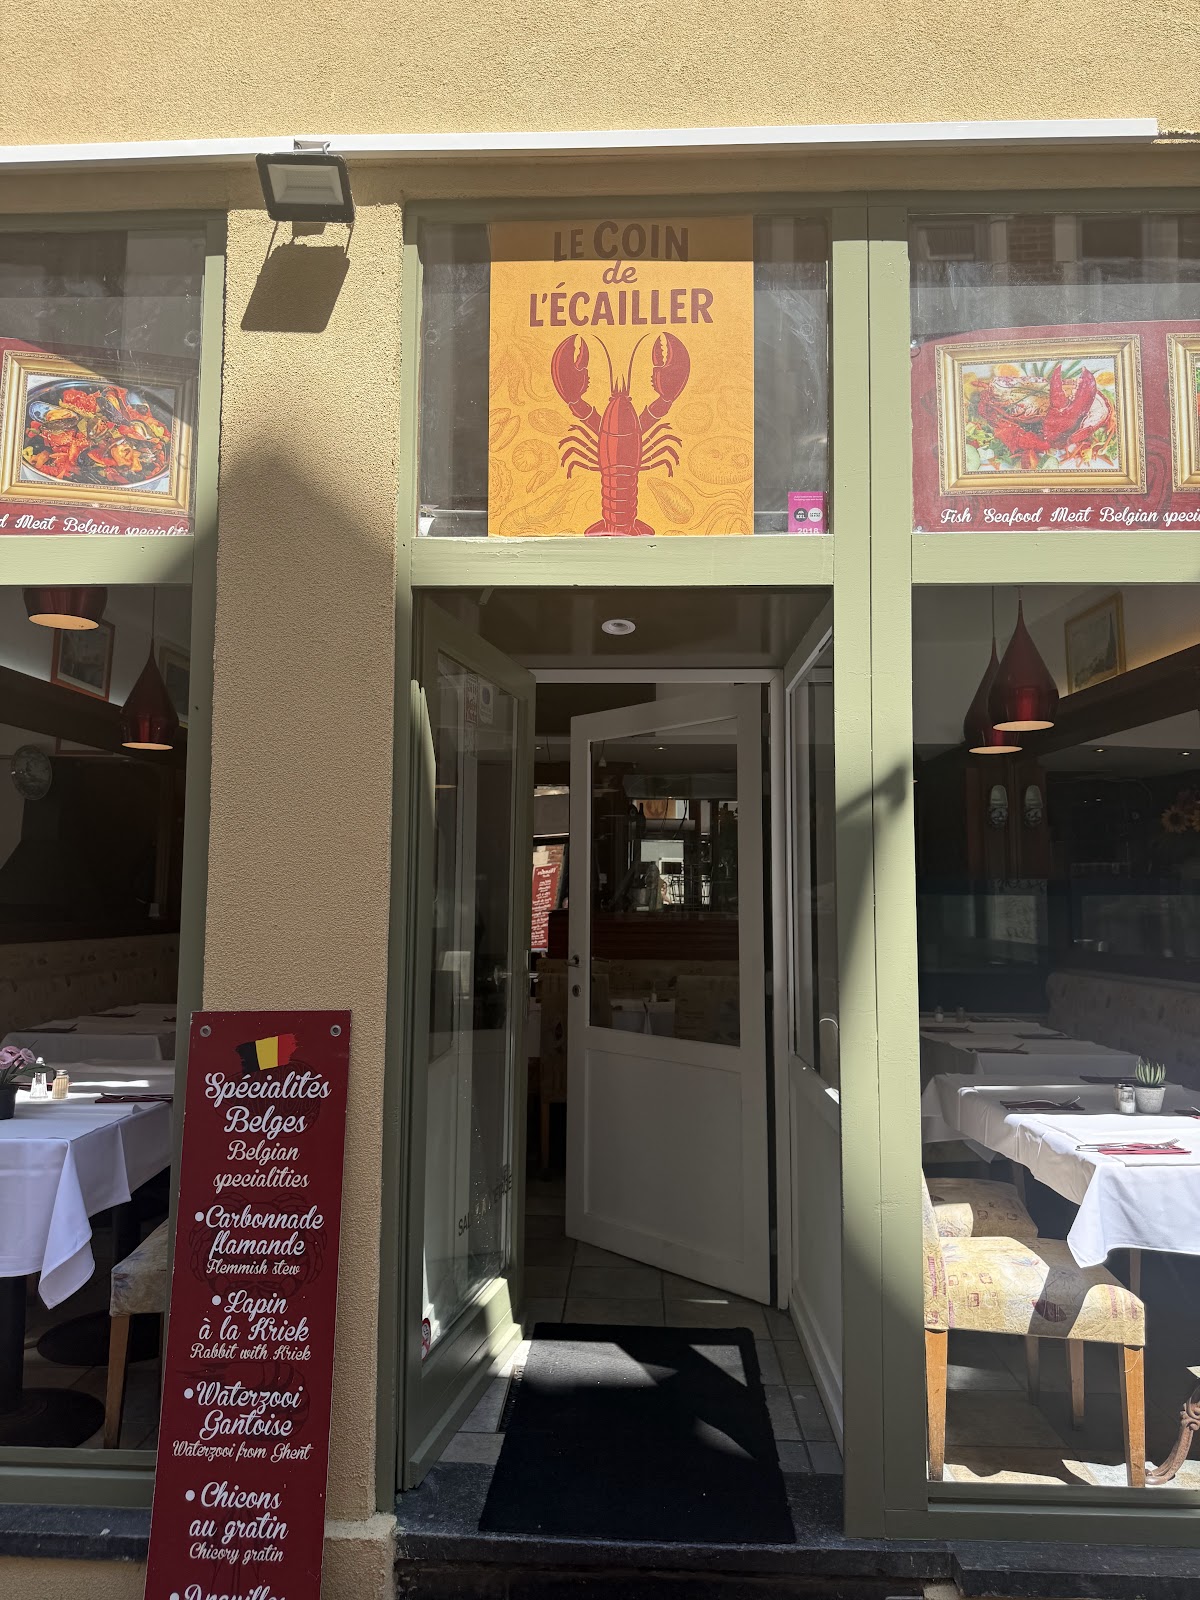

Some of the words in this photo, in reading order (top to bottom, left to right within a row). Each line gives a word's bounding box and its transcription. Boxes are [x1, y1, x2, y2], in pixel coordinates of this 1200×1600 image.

[553, 229, 585, 262] LE
[593, 220, 689, 262] COIN
[602, 261, 639, 285] de
[529, 282, 714, 327] L'ÉCAILLER
[15, 514, 58, 530] Meat
[63, 517, 120, 535] Belgian
[940, 507, 972, 523] Fish
[984, 507, 1043, 526] Seafood
[1050, 507, 1094, 522] Meat
[1099, 506, 1159, 526] Belgian
[1163, 508, 1200, 527] speci
[205, 1071, 332, 1108] Spécialités
[224, 1105, 308, 1140] Belges
[227, 1140, 301, 1166] Belgian
[213, 1166, 310, 1194] specialities
[206, 1204, 325, 1230] Carbonnade
[208, 1230, 306, 1260] flamande
[206, 1258, 269, 1275] Flemmish
[271, 1260, 301, 1276] stew
[224, 1289, 289, 1322] Lapin
[198, 1317, 214, 1340] à
[219, 1315, 242, 1341] la
[248, 1315, 310, 1342] Kriek
[189, 1343, 239, 1360] Rabbit
[240, 1344, 268, 1360] with
[272, 1345, 312, 1361] Kriek
[196, 1380, 304, 1415] Waterzooi
[199, 1409, 294, 1441] Gantoise
[172, 1440, 236, 1462] Waterzooi
[236, 1441, 267, 1462] from
[270, 1443, 314, 1463] Ghent
[200, 1480, 283, 1510] Chicons
[188, 1519, 218, 1538] au
[220, 1512, 289, 1545] gratin
[189, 1541, 240, 1565] Chicory
[242, 1544, 284, 1566] gratin
